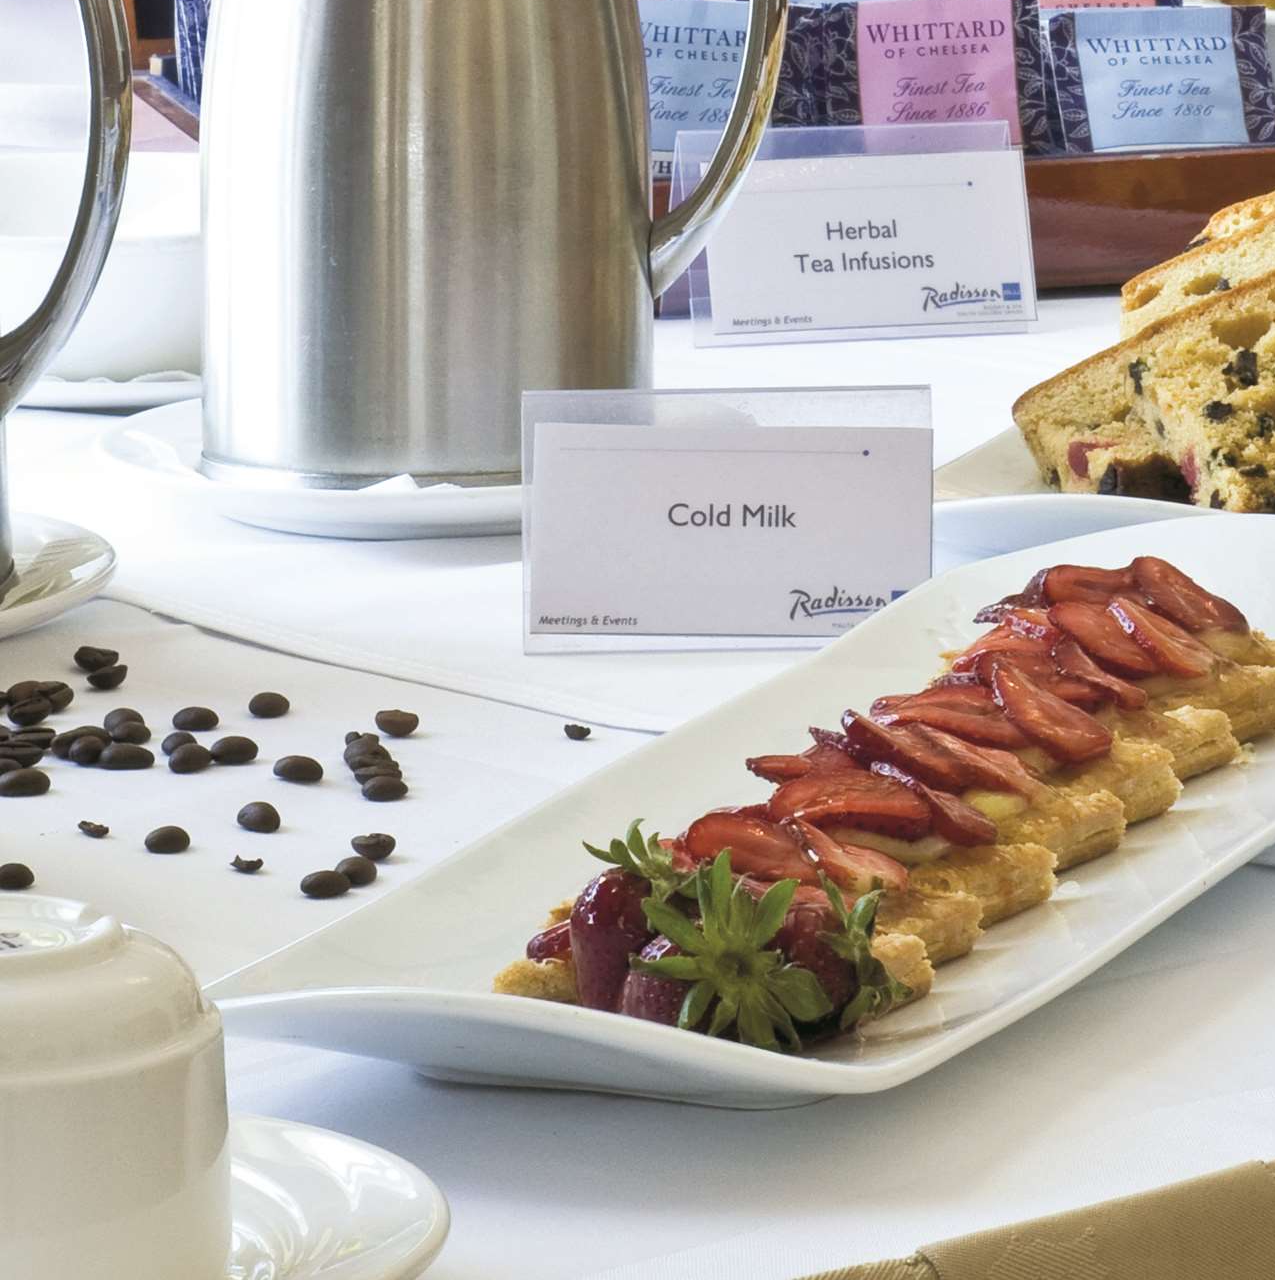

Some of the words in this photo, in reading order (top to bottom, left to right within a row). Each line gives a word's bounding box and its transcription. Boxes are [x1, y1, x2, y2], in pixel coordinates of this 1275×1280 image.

[866, 19, 1005, 44] WHITTARD
[674, 49, 739, 63] CHELSE
[884, 48, 905, 59] OF
[916, 43, 990, 57] CHELSEA
[1086, 36, 1228, 55] WHITTARD
[1107, 57, 1129, 67] OF
[1139, 55, 1214, 66] CHELSEA
[893, 76, 948, 98] Finest
[952, 73, 986, 95] Tea
[1118, 79, 1174, 98] Finest
[1178, 77, 1212, 97] Tea
[886, 101, 937, 123] Since
[945, 101, 990, 120] 1886
[1112, 101, 1164, 120] Since
[1174, 103, 1216, 118] 1886
[826, 218, 898, 241] Herbal
[793, 253, 835, 274] Tea
[842, 251, 935, 272] Infusions
[921, 281, 1001, 312] Radisson
[668, 502, 731, 527] Cold
[742, 503, 797, 528] Milk
[789, 586, 887, 621] Radisson
[538, 615, 588, 628] Meetings
[590, 615, 599, 626] &
[602, 614, 638, 626] Events
